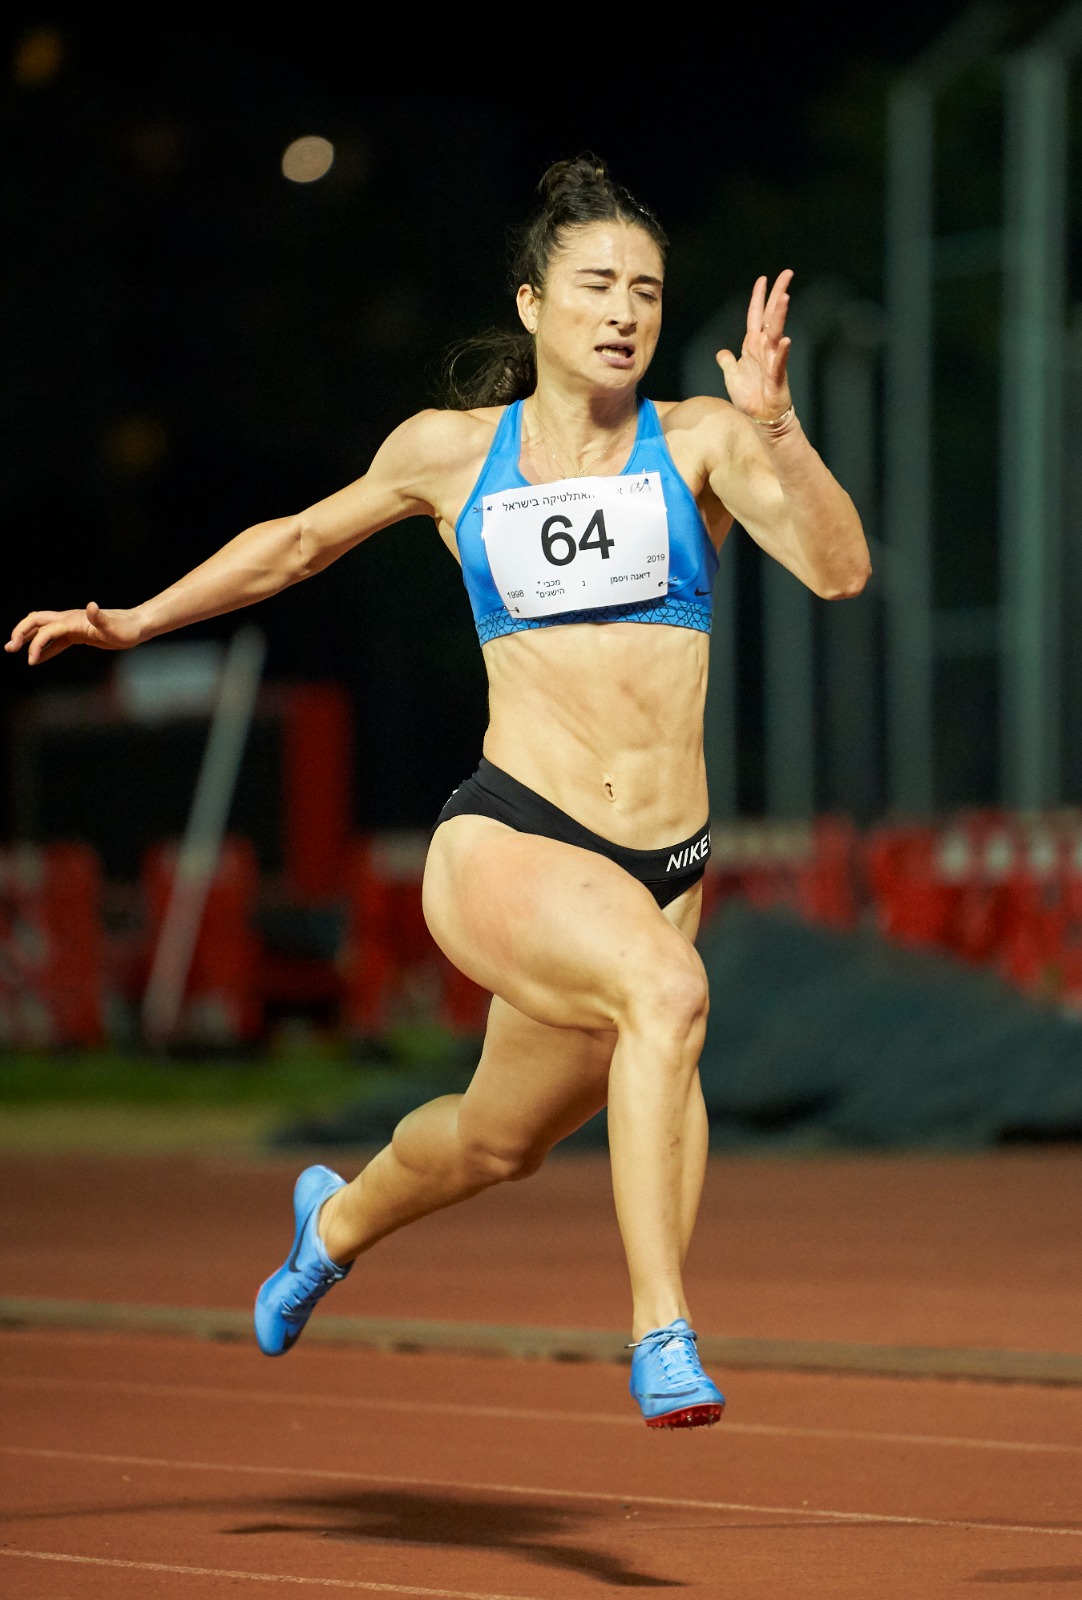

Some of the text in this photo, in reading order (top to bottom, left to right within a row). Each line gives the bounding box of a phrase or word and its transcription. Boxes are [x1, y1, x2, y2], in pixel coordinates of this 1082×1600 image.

[502, 498, 540, 511] בישראל
[541, 508, 615, 566] 64
[646, 553, 666, 563] 2019
[543, 579, 561, 587] מכבי
[610, 571, 651, 584] דיאנה ויסמן
[507, 589, 525, 599] 1998
[665, 834, 709, 872] NIKE
